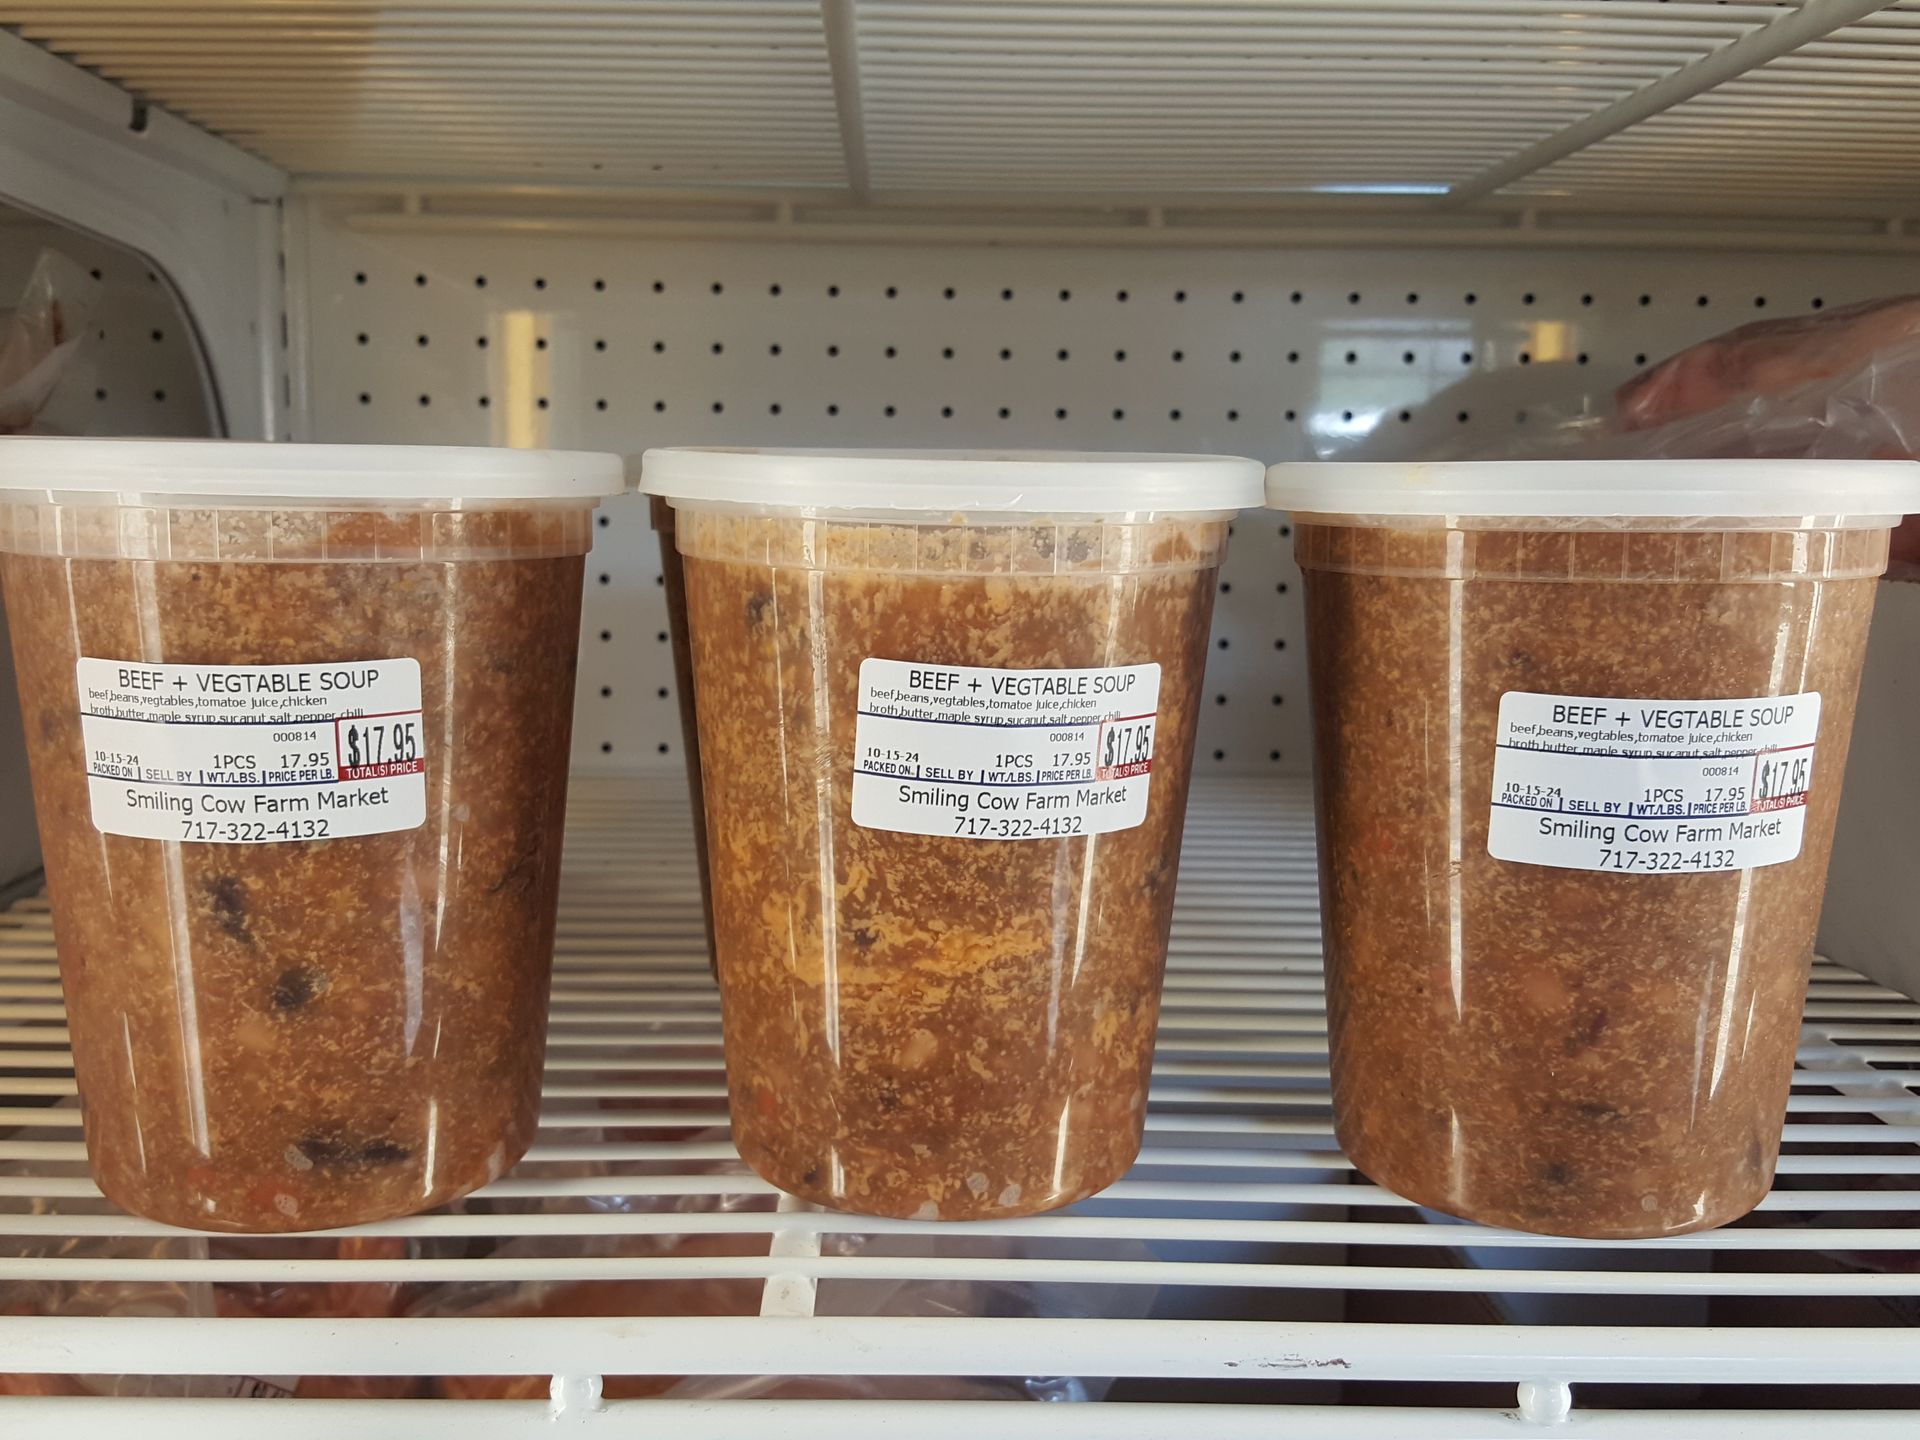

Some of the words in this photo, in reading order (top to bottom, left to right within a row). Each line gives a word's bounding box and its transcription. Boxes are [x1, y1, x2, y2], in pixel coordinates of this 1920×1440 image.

[119, 669, 164, 691] BEEF
[173, 676, 188, 691] +
[196, 673, 312, 693] VEGTABLE
[320, 669, 379, 691] SOUP
[909, 670, 960, 691] BEEF
[967, 677, 982, 693] +
[991, 676, 1088, 696] VEGTABLE
[1093, 673, 1136, 694] SOUP
[1553, 704, 1607, 726] BEEF
[1615, 711, 1631, 727] +
[1641, 709, 1744, 729] VEGTABLE
[1750, 705, 1794, 727] SOUP
[273, 731, 317, 742] 000814
[1050, 732, 1085, 743] 000814
[348, 722, 416, 768] $17.95
[1104, 724, 1151, 767] $17.95
[95, 751, 139, 765] 10-15-24
[213, 754, 256, 769] 1PCS
[280, 752, 330, 769] 17.95
[867, 747, 919, 763] 10-15-24
[995, 754, 1033, 768] 1PCS
[1053, 752, 1091, 767] 17.95
[93, 762, 121, 777] PACKED
[122, 766, 133, 778] ON
[145, 768, 174, 781] SELL
[177, 771, 192, 782] BY
[269, 771, 297, 782] PRICE
[300, 769, 318, 781] PER
[320, 768, 335, 779] LB.
[390, 761, 418, 775] PRICE
[863, 759, 896, 774] PACKED
[898, 764, 911, 775] ON
[925, 767, 954, 779] SELL
[957, 769, 974, 781] BY
[1041, 770, 1064, 781] PRICE
[1066, 769, 1079, 780] PER
[1082, 768, 1093, 779] LB.
[1130, 762, 1148, 775] PRICE
[1702, 766, 1739, 777] 000814
[1759, 758, 1807, 798] $17.95
[1505, 782, 1562, 798] 10-15-24
[1644, 788, 1684, 803] 1PCS
[1705, 786, 1746, 802] 17.95
[126, 789, 193, 816] Smiling
[201, 794, 246, 814] Cow
[254, 795, 309, 813] Farm
[317, 787, 389, 810] Market
[899, 785, 969, 812] Smiling
[977, 792, 1020, 810] Cow
[1026, 792, 1070, 810] Farm
[1076, 785, 1127, 807] Market
[1501, 792, 1537, 807] PACKED
[1539, 796, 1553, 808] ON
[1568, 799, 1600, 812] SELL
[1603, 802, 1622, 813] BY
[1693, 803, 1717, 814] PRICE
[1719, 802, 1734, 813] PER
[1736, 801, 1747, 812] LB.
[181, 819, 330, 841] 717-322-4132
[955, 816, 1082, 837] 717-322-4132
[1539, 817, 1615, 844] Smiling
[1624, 824, 1669, 843] Cow
[1675, 824, 1722, 843] Farm
[1729, 817, 1782, 840] Market
[1600, 849, 1735, 870] 717-322-4132
